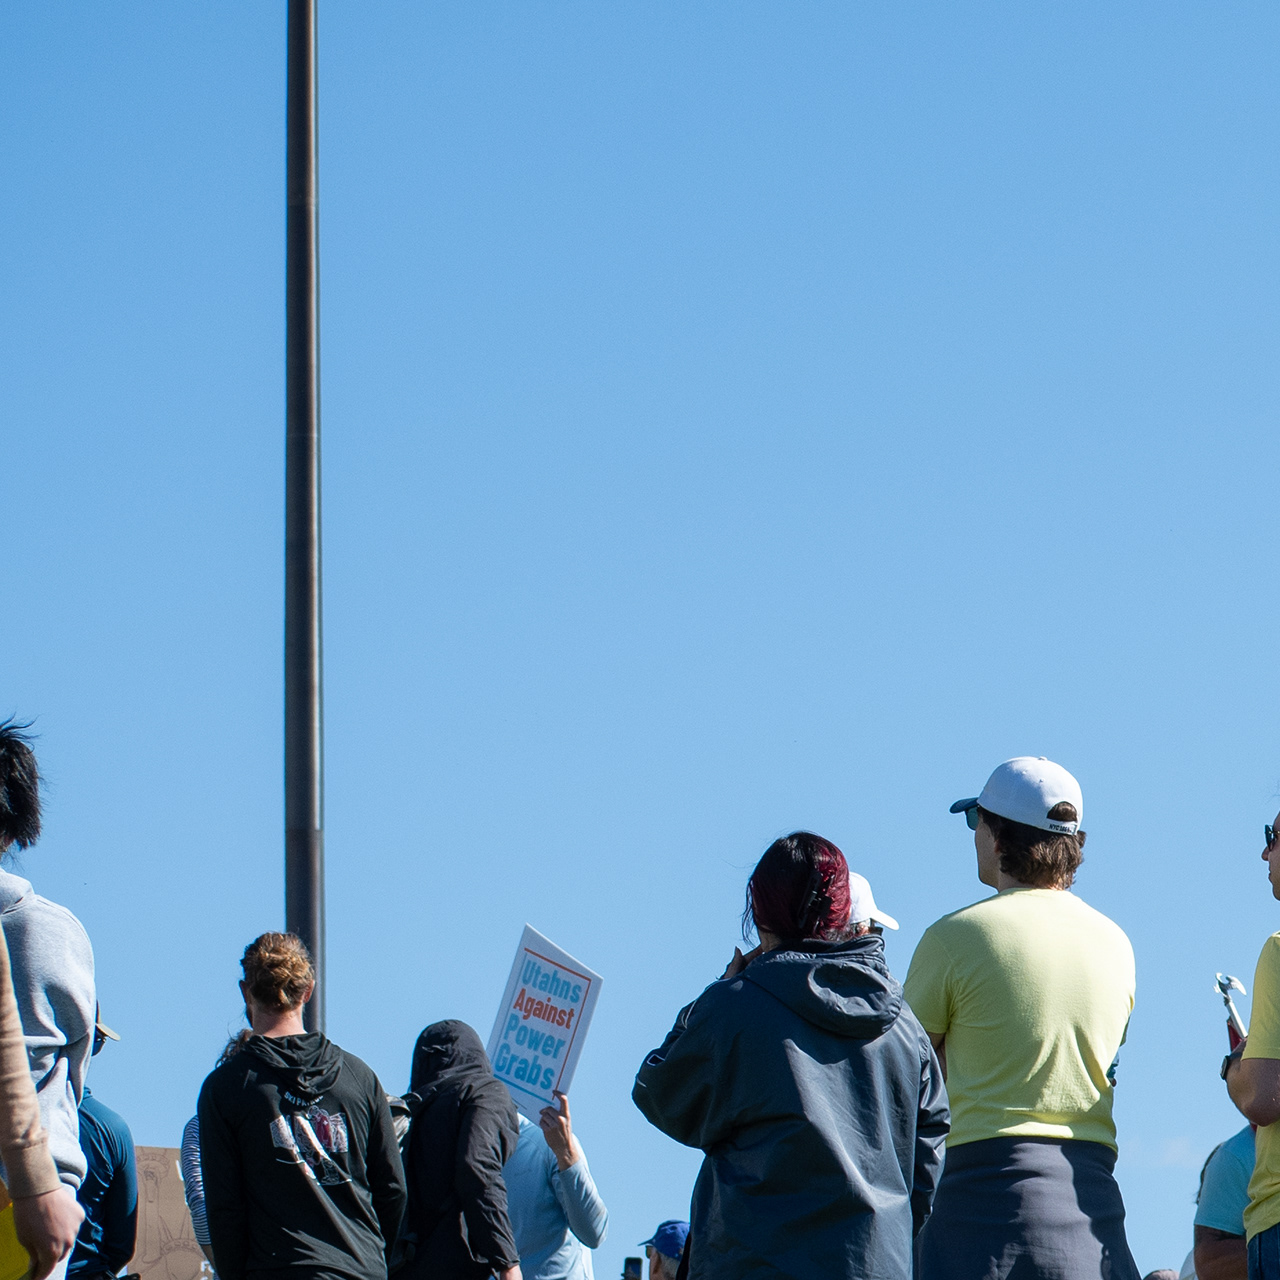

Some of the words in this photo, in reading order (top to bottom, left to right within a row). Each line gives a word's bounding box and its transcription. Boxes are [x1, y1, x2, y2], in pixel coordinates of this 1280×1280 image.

[521, 959, 583, 1004] Utahns
[512, 988, 575, 1030] Against
[503, 1013, 567, 1060] Power
[494, 1043, 556, 1091] Grabs
